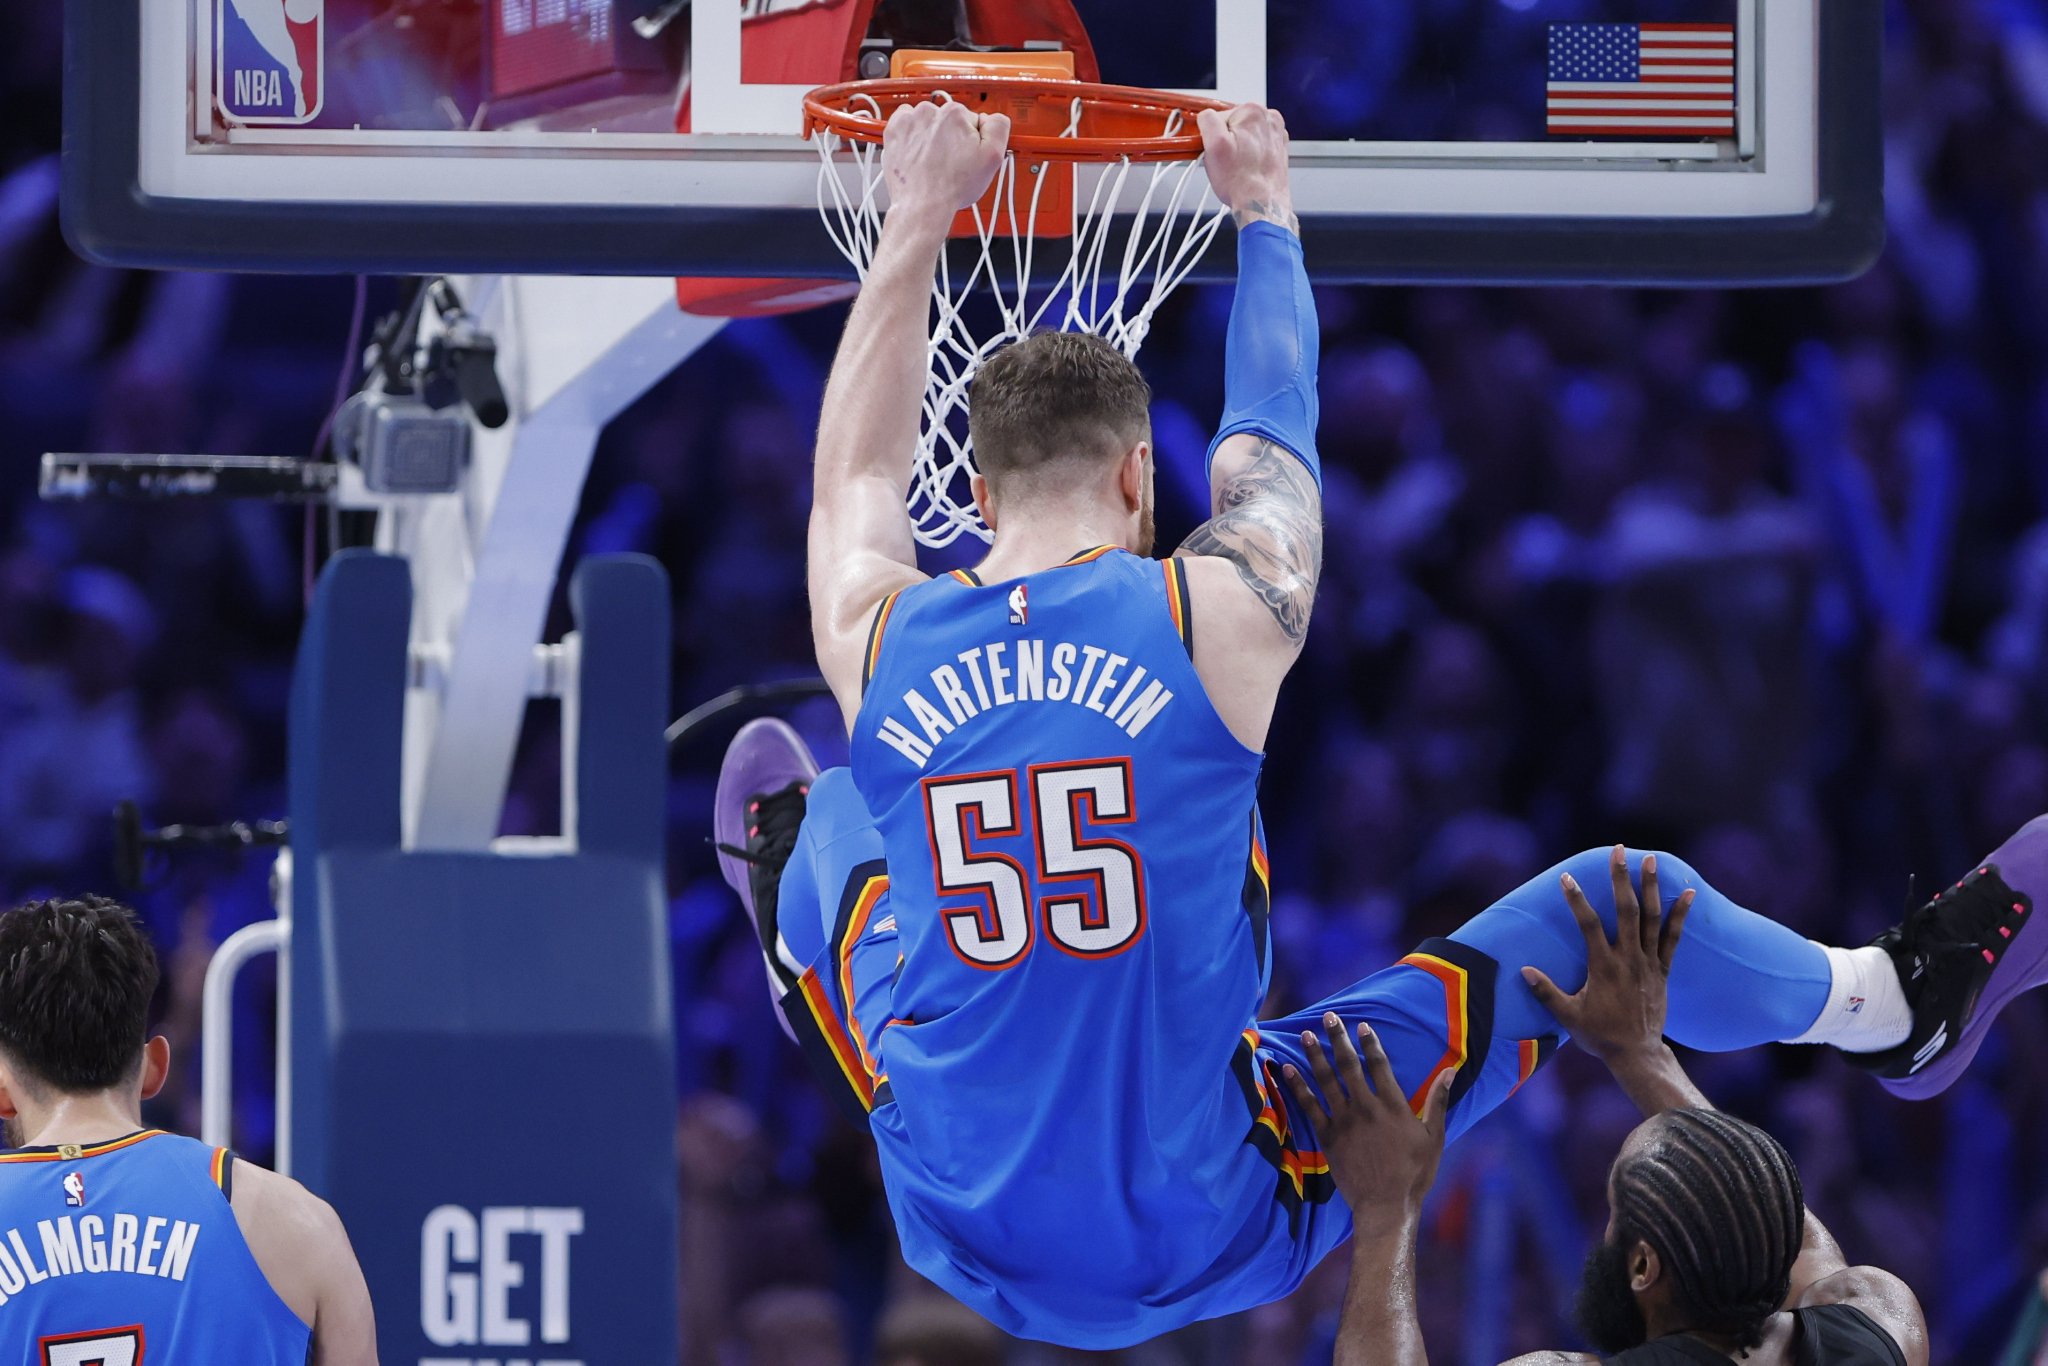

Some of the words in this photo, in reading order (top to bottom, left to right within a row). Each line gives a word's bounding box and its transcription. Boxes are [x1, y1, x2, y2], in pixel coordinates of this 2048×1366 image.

[234, 69, 283, 106] NBA
[876, 638, 1175, 769] HARTENSTEIN
[920, 755, 1149, 972] 55
[0, 1213, 201, 1307] OLMGREN
[420, 1203, 586, 1348] GET
